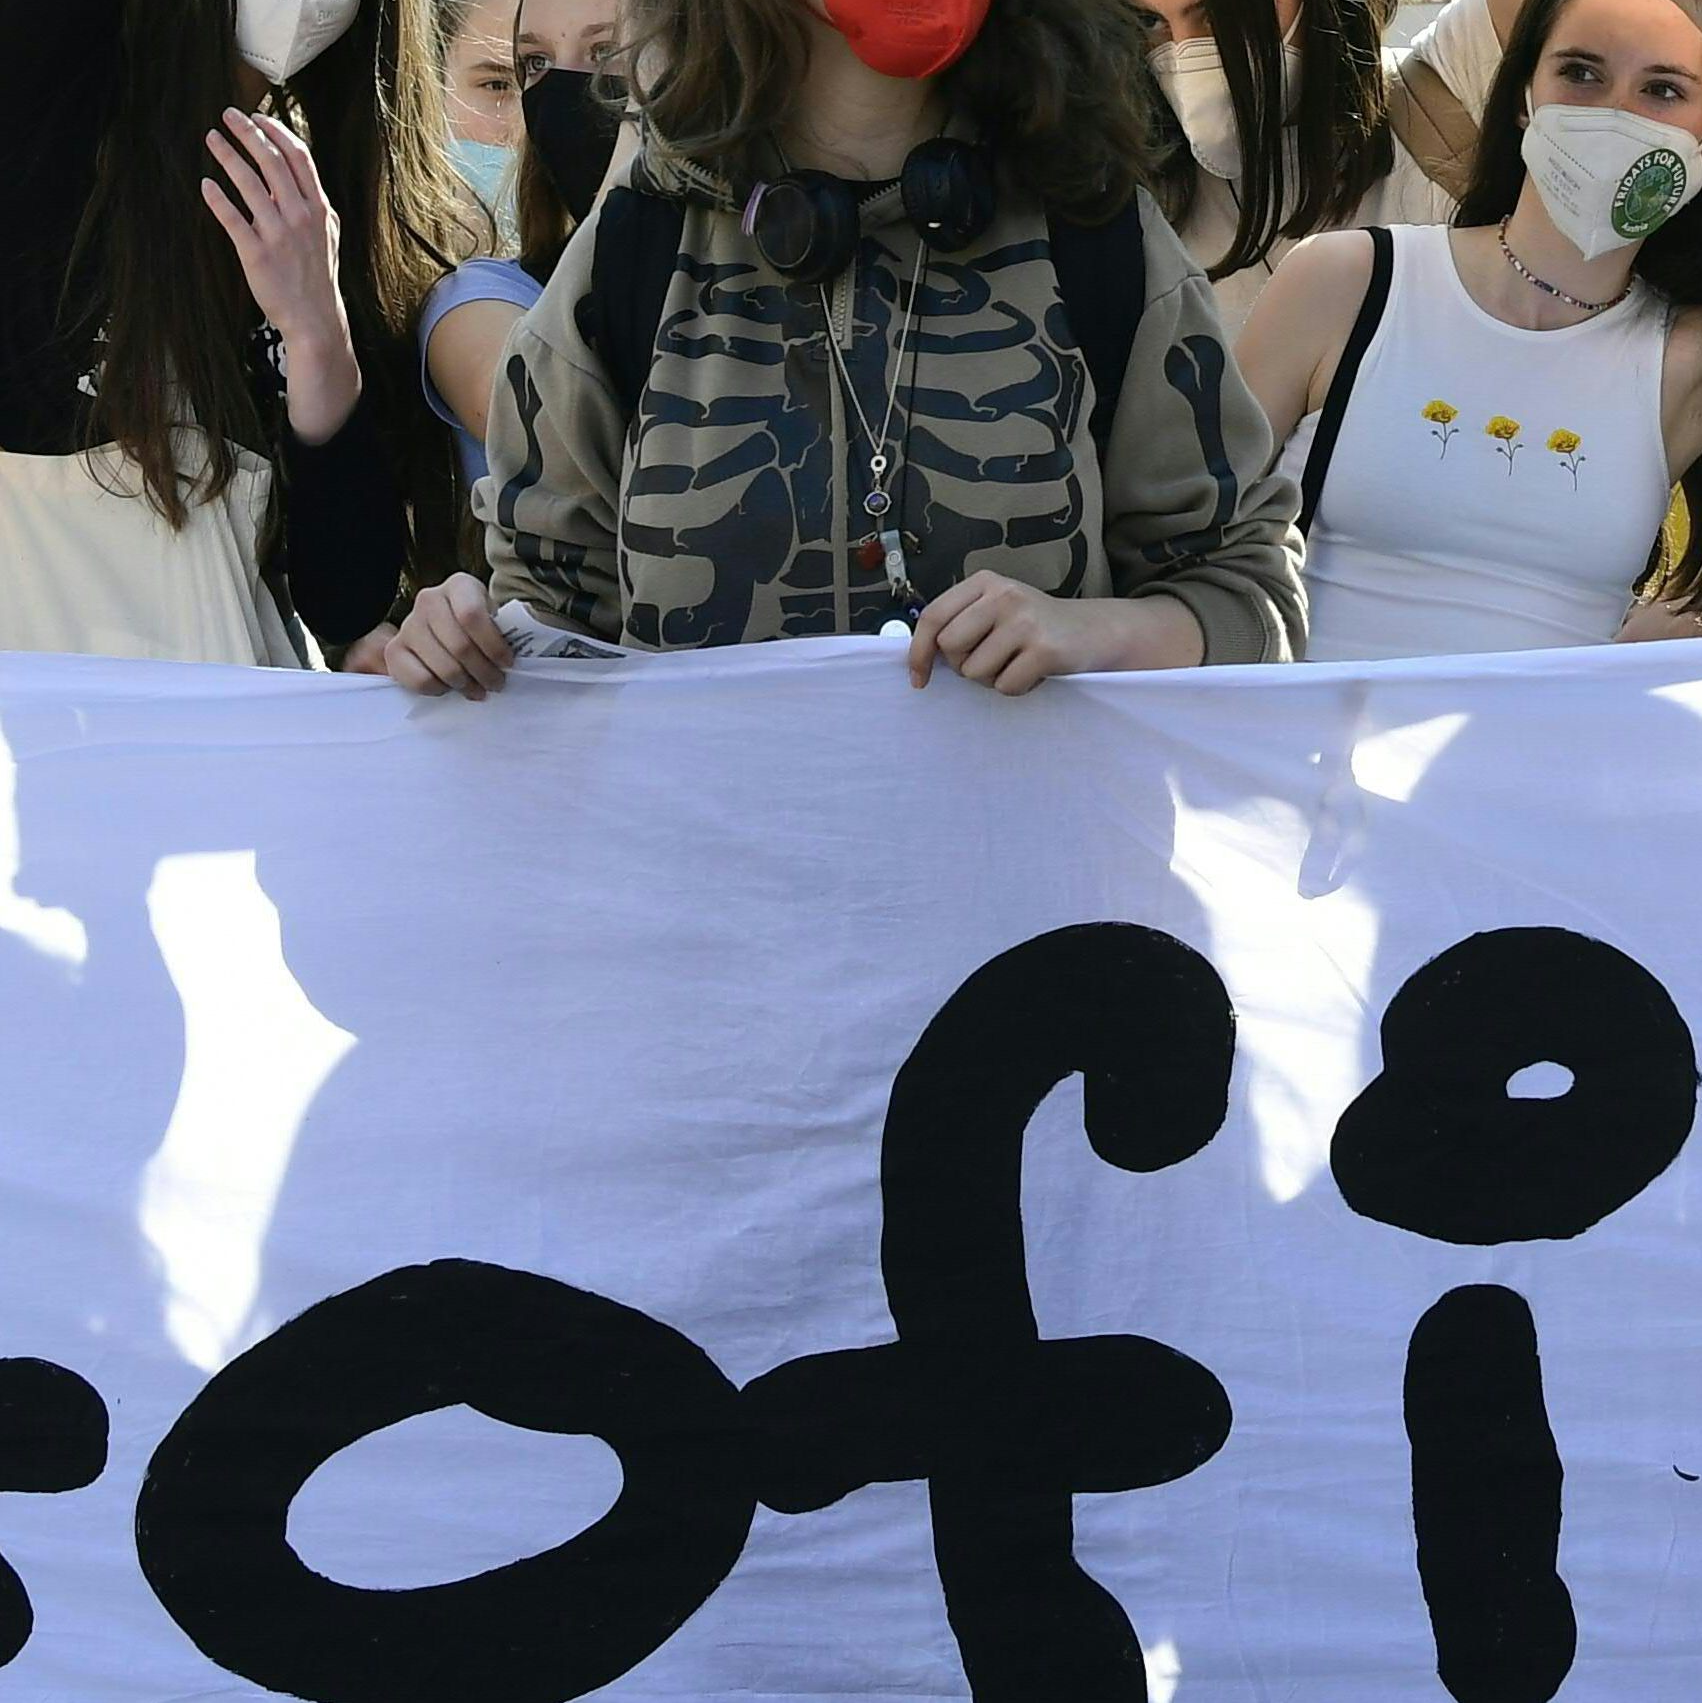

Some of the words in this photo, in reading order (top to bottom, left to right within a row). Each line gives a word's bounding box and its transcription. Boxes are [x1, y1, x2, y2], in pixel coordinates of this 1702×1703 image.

[1614, 153, 1651, 208] FRIDAYS
[1653, 151, 1675, 169] FOR
[1662, 162, 1685, 213] FUTURE
